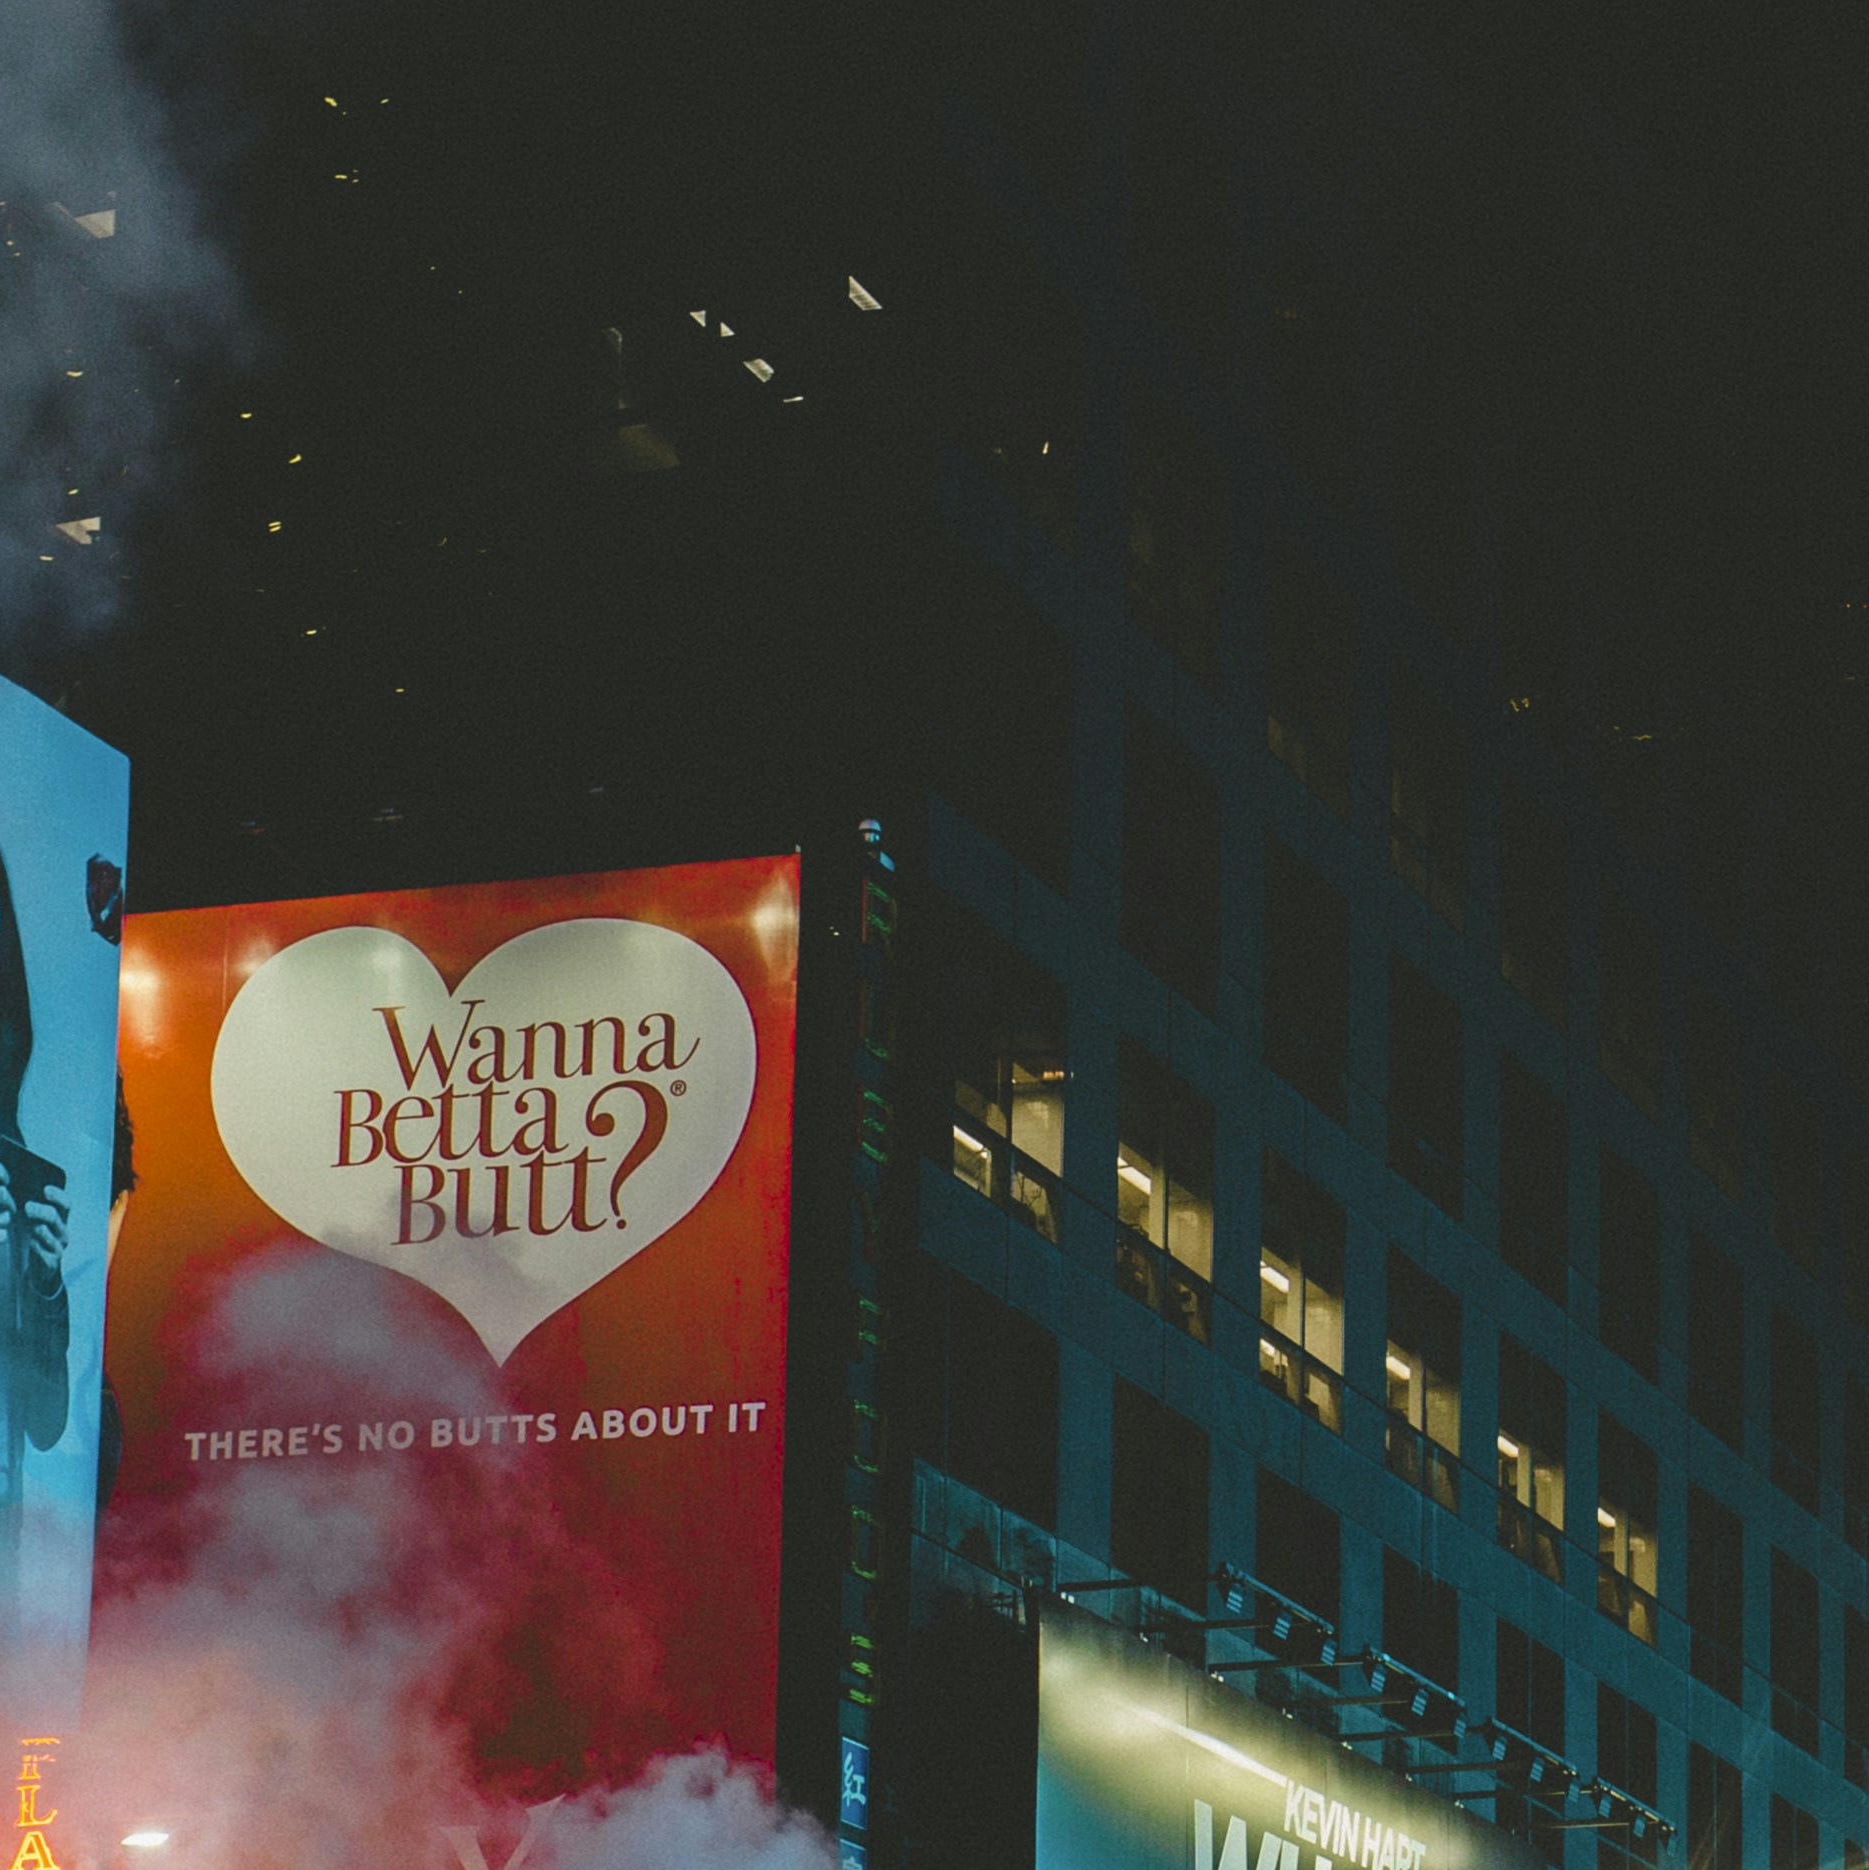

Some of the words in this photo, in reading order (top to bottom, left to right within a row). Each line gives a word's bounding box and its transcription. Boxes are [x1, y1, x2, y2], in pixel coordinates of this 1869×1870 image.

[372, 1000, 701, 1091] Wanna
[331, 1080, 569, 1169] Betta
[185, 1424, 342, 1461] THERE'S
[358, 1421, 416, 1453] NO
[429, 1412, 557, 1448] BUTTS
[571, 1403, 714, 1441] ABOUT
[727, 1401, 767, 1434] IT
[1283, 1780, 1360, 1862] KEVIN
